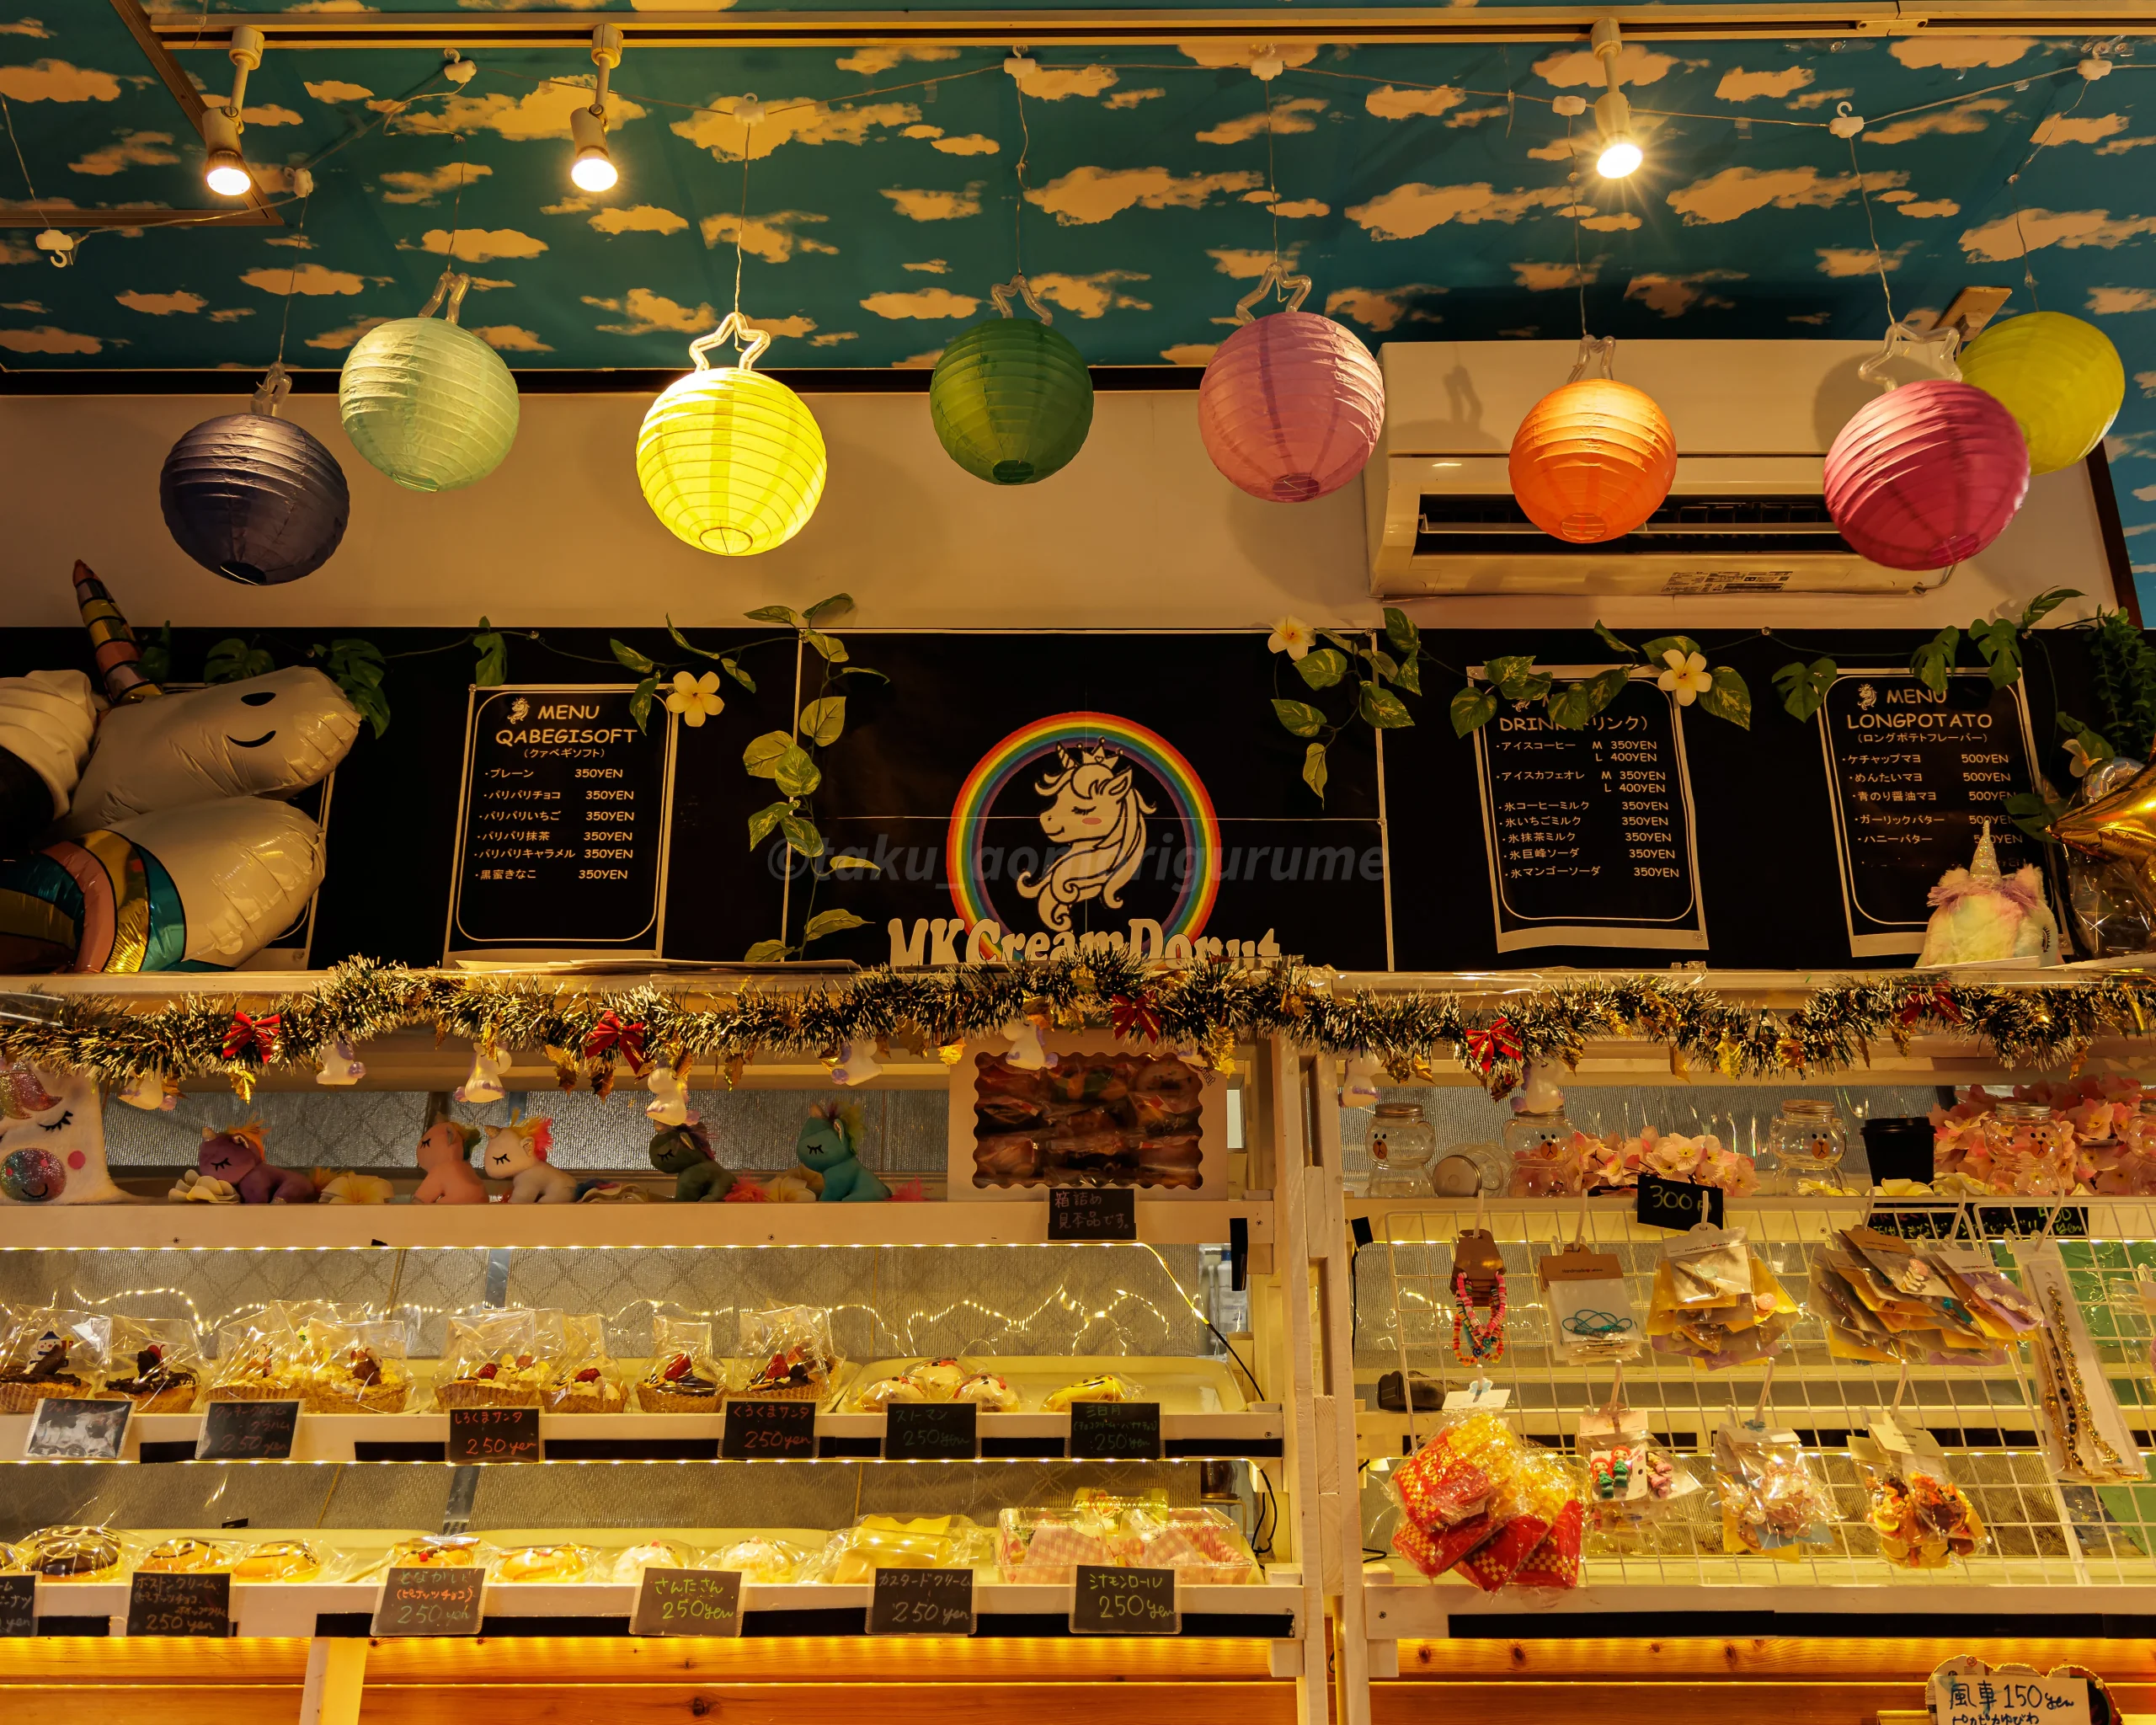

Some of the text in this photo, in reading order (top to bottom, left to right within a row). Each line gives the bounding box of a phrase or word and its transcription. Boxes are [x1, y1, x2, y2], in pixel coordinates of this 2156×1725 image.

[1886, 689, 1948, 703] MENU
[537, 705, 600, 719] MENU
[1847, 713, 1992, 729] LONGPOTATO
[496, 729, 637, 746] QABEGISOFT
[1611, 741, 1657, 750] 350YEN
[1596, 753, 1657, 761] L 400YEN
[1961, 754, 2009, 763] 500YEN
[575, 768, 622, 778] 350YEN
[1620, 772, 1665, 780] 350YEN
[1963, 772, 2010, 782] 500YEN
[1604, 783, 1665, 793] L 400YEN
[585, 791, 633, 800] 350YEN
[1622, 802, 1668, 810] 350YEN
[586, 811, 634, 821] 350YEN
[1622, 817, 1668, 825] 350YEN
[584, 831, 632, 841] 350YEN
[1625, 832, 1671, 841] 350YEN
[584, 849, 633, 858] 350YEN
[1630, 849, 1675, 858] 350YEN
[579, 869, 627, 879] 350YEN
[1634, 868, 1678, 877] 350YEN
[1055, 1191, 1102, 1208] 箱詰め
